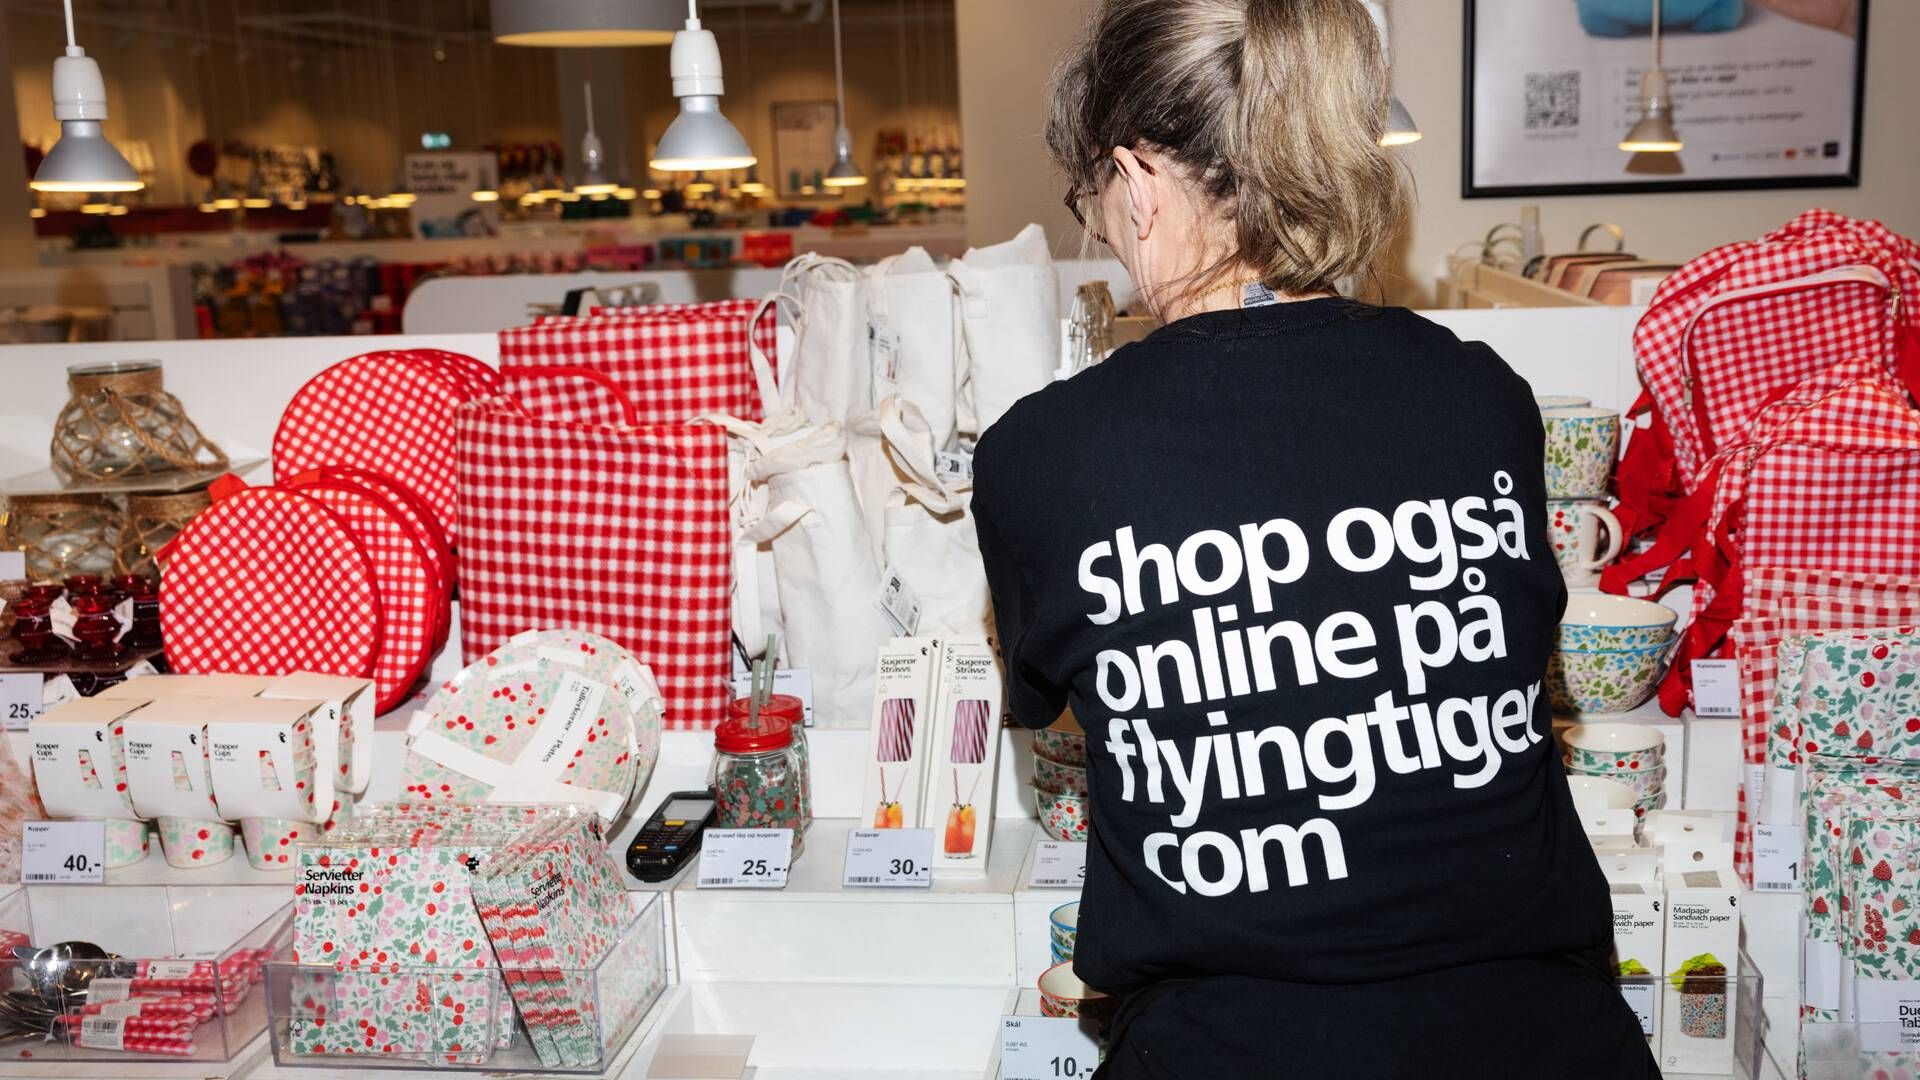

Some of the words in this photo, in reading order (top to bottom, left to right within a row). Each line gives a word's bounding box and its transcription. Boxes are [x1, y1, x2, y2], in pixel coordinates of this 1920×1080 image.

[1078, 517, 1310, 626] Shop
[1326, 470, 1531, 591] også
[1095, 604, 1379, 713] online
[1394, 567, 1507, 695] på
[9, 703, 43, 720] 25,-
[1105, 681, 1544, 828] flyingtiger
[64, 854, 101, 873] 40,-
[1143, 817, 1349, 897] com
[305, 869, 365, 881] Servietter
[889, 858, 928, 877] 30,-
[305, 882, 355, 897] Napkins
[536, 886, 565, 911] Napkins
[1673, 906, 1711, 915] Madpapir
[1673, 913, 1708, 921] Sandwich
[1633, 920, 1655, 928] paper
[1005, 1020, 1021, 1028] Skål
[1050, 1056, 1094, 1080] 10,-
